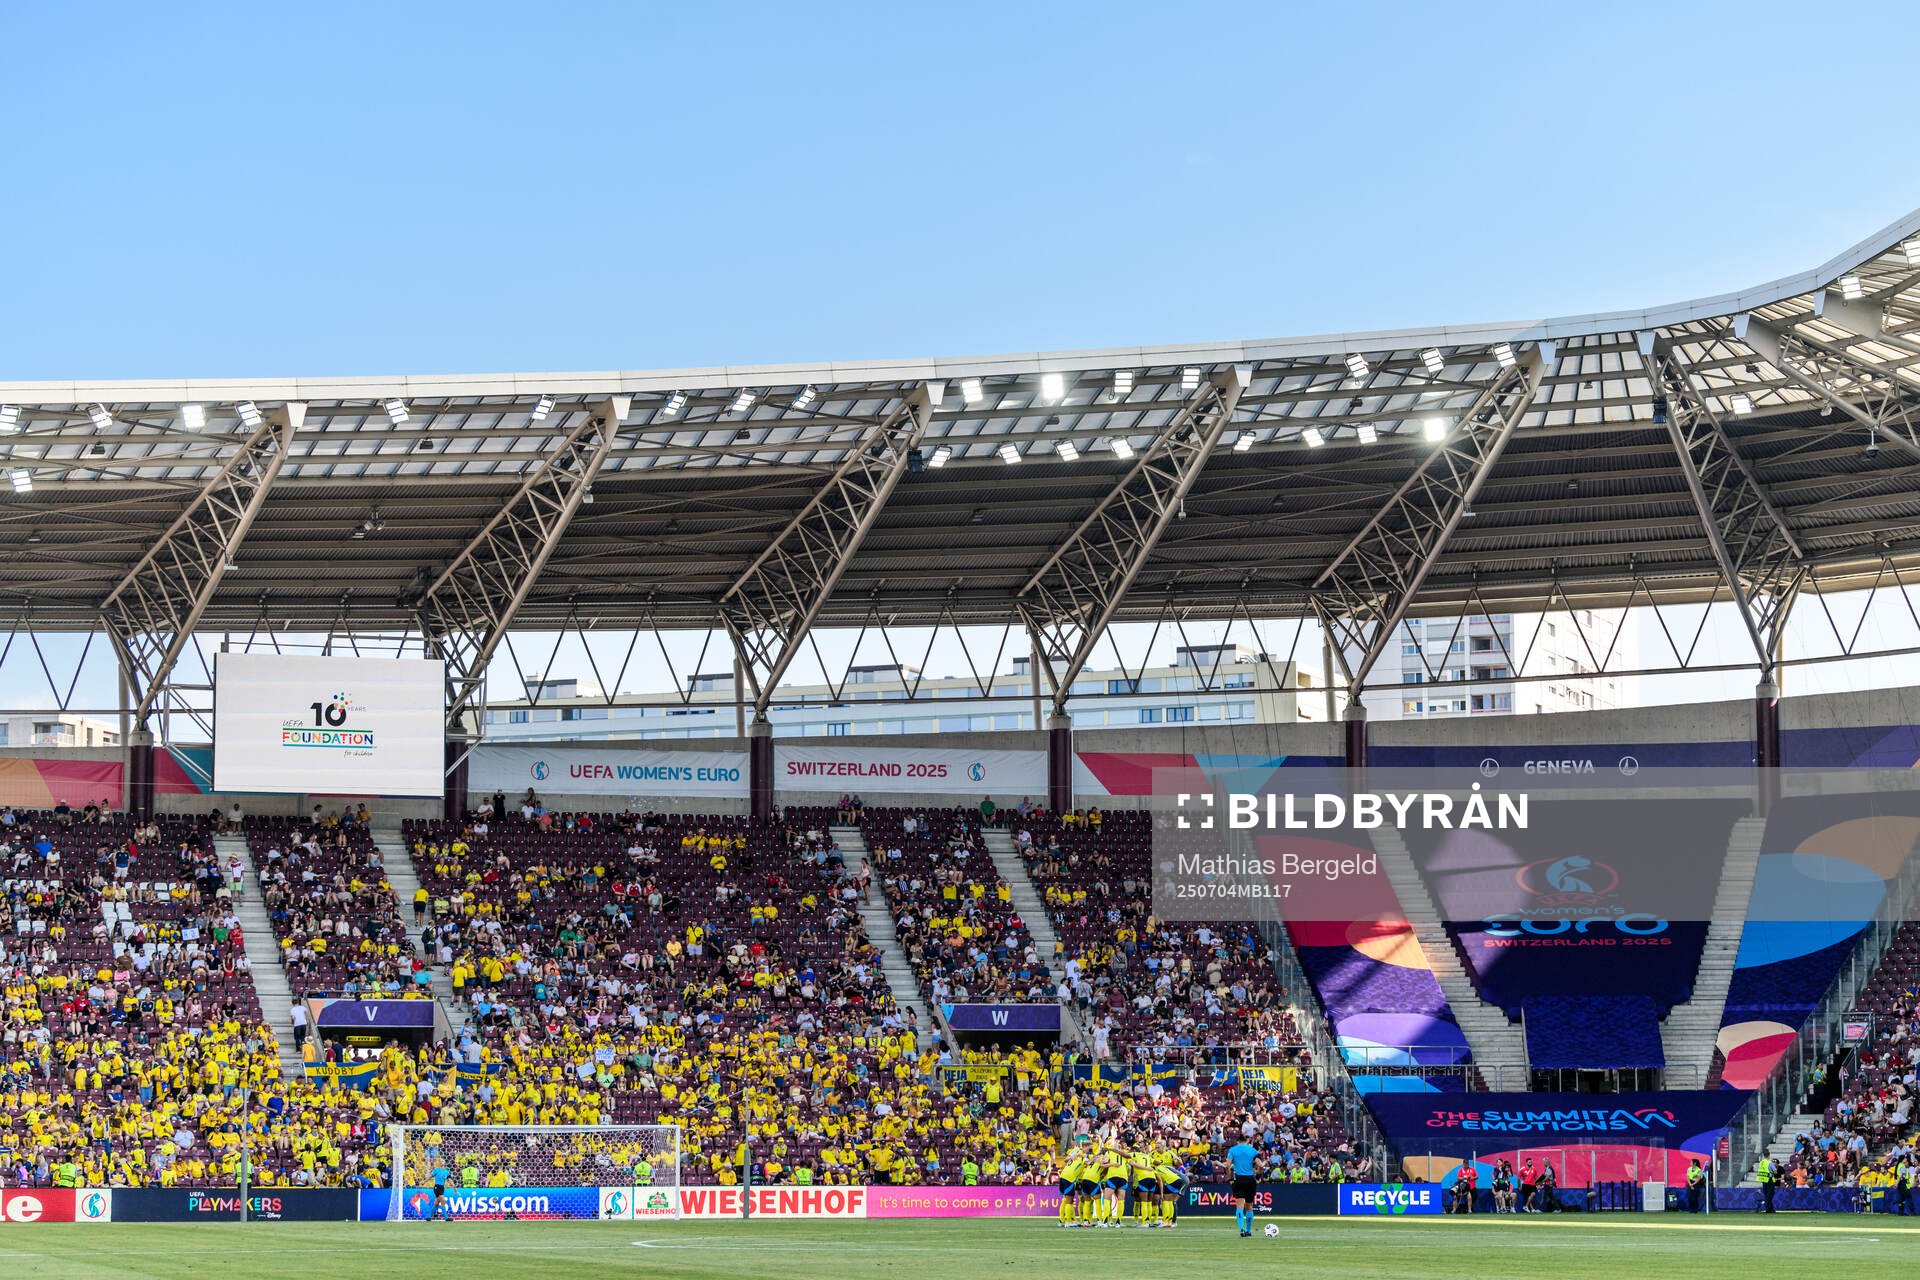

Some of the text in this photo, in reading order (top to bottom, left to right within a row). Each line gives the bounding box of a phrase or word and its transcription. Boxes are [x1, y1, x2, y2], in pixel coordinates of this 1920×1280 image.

[310, 702, 347, 726] 10
[282, 732, 374, 745] FOUNDATION
[570, 764, 741, 781] UEFA WOMEN'S EURO
[787, 761, 947, 778] SWITZERLAND 2025
[1523, 760, 1595, 774] GENEVA
[1484, 938, 1672, 948] SWITZERLAND 2025
[365, 1006, 378, 1021] V
[991, 1010, 1009, 1025] W
[316, 1067, 354, 1075] KUDDBY
[944, 1070, 967, 1080] HEJA
[1242, 1069, 1265, 1078] HEJA
[1433, 1110, 1610, 1121] THE SUMMIT
[1427, 1119, 1627, 1131] OF EMOTIONS
[189, 1197, 282, 1212] PLAYMAKERS
[680, 1190, 864, 1214] WIESENHOF
[880, 1196, 1077, 1208] It's time to come OFF MUE
[1351, 1190, 1430, 1206] RECYCLE
[635, 1208, 677, 1216] WIESENHO
